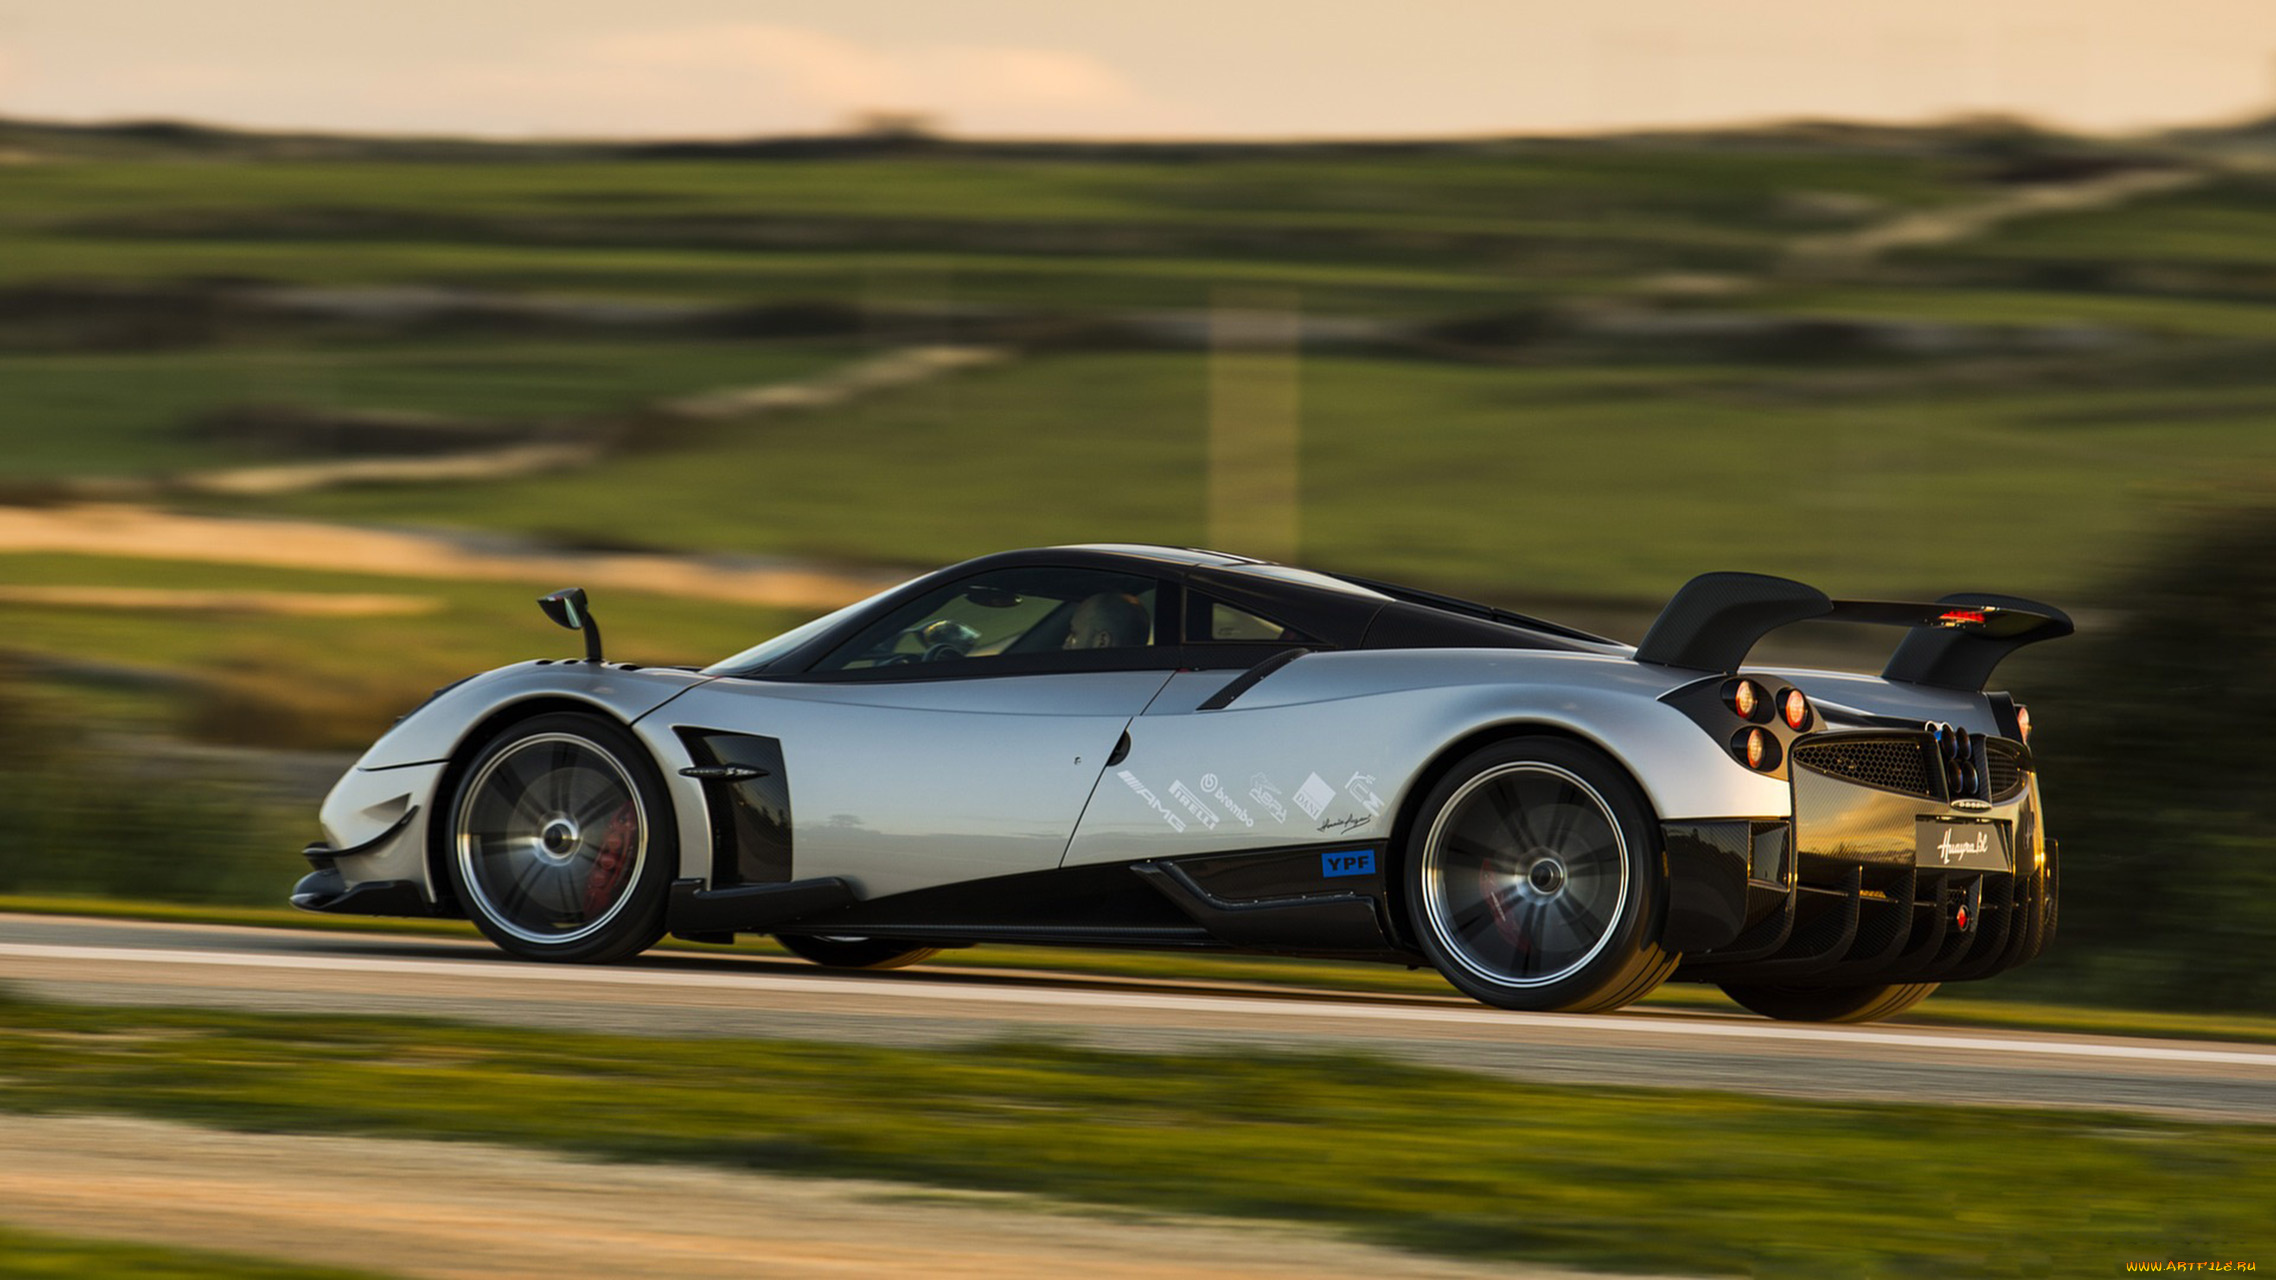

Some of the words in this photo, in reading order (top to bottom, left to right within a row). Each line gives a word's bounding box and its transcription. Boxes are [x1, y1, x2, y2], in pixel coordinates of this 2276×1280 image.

[1136, 788, 1187, 833] AMG
[1168, 779, 1221, 831] PIRELLI
[1214, 787, 1254, 828] brembo
[1295, 792, 1321, 818] DANI
[1327, 855, 1370, 871] YPF
